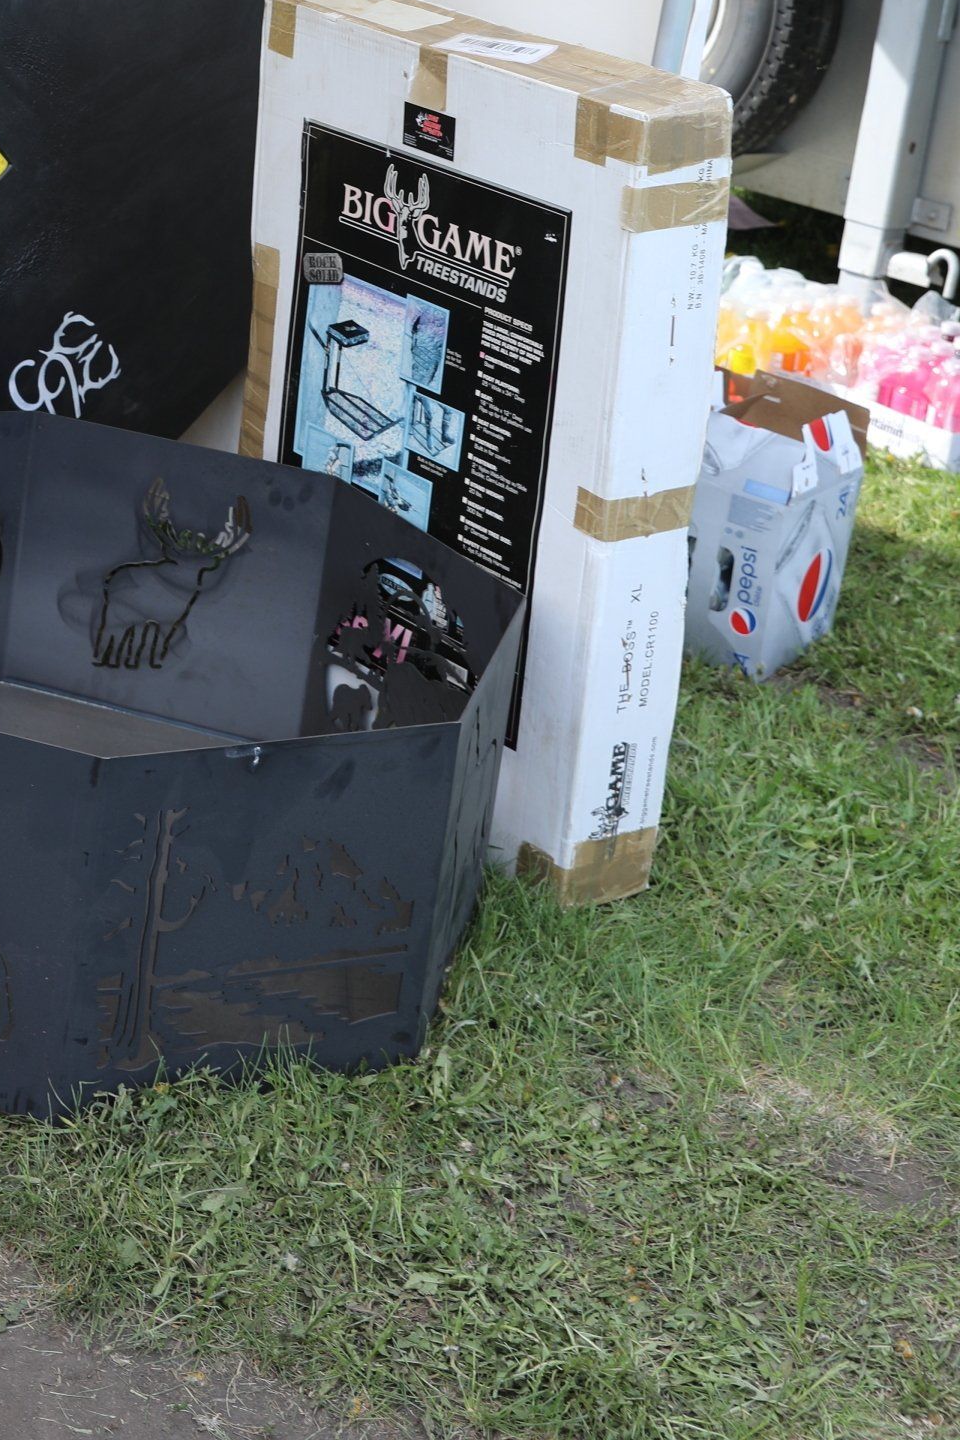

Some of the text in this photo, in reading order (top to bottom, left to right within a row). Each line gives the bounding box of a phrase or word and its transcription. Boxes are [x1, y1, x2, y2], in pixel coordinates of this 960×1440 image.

[341, 183, 397, 234] BIG
[416, 256, 507, 303] TREESTANDS
[484, 306, 533, 332] PRODUCT SPECS
[736, 545, 759, 605] pepsi
[616, 683, 632, 714] THE
[630, 583, 643, 602] XL
[639, 610, 660, 708] MODEL:CR1100
[605, 742, 628, 810] GAME
